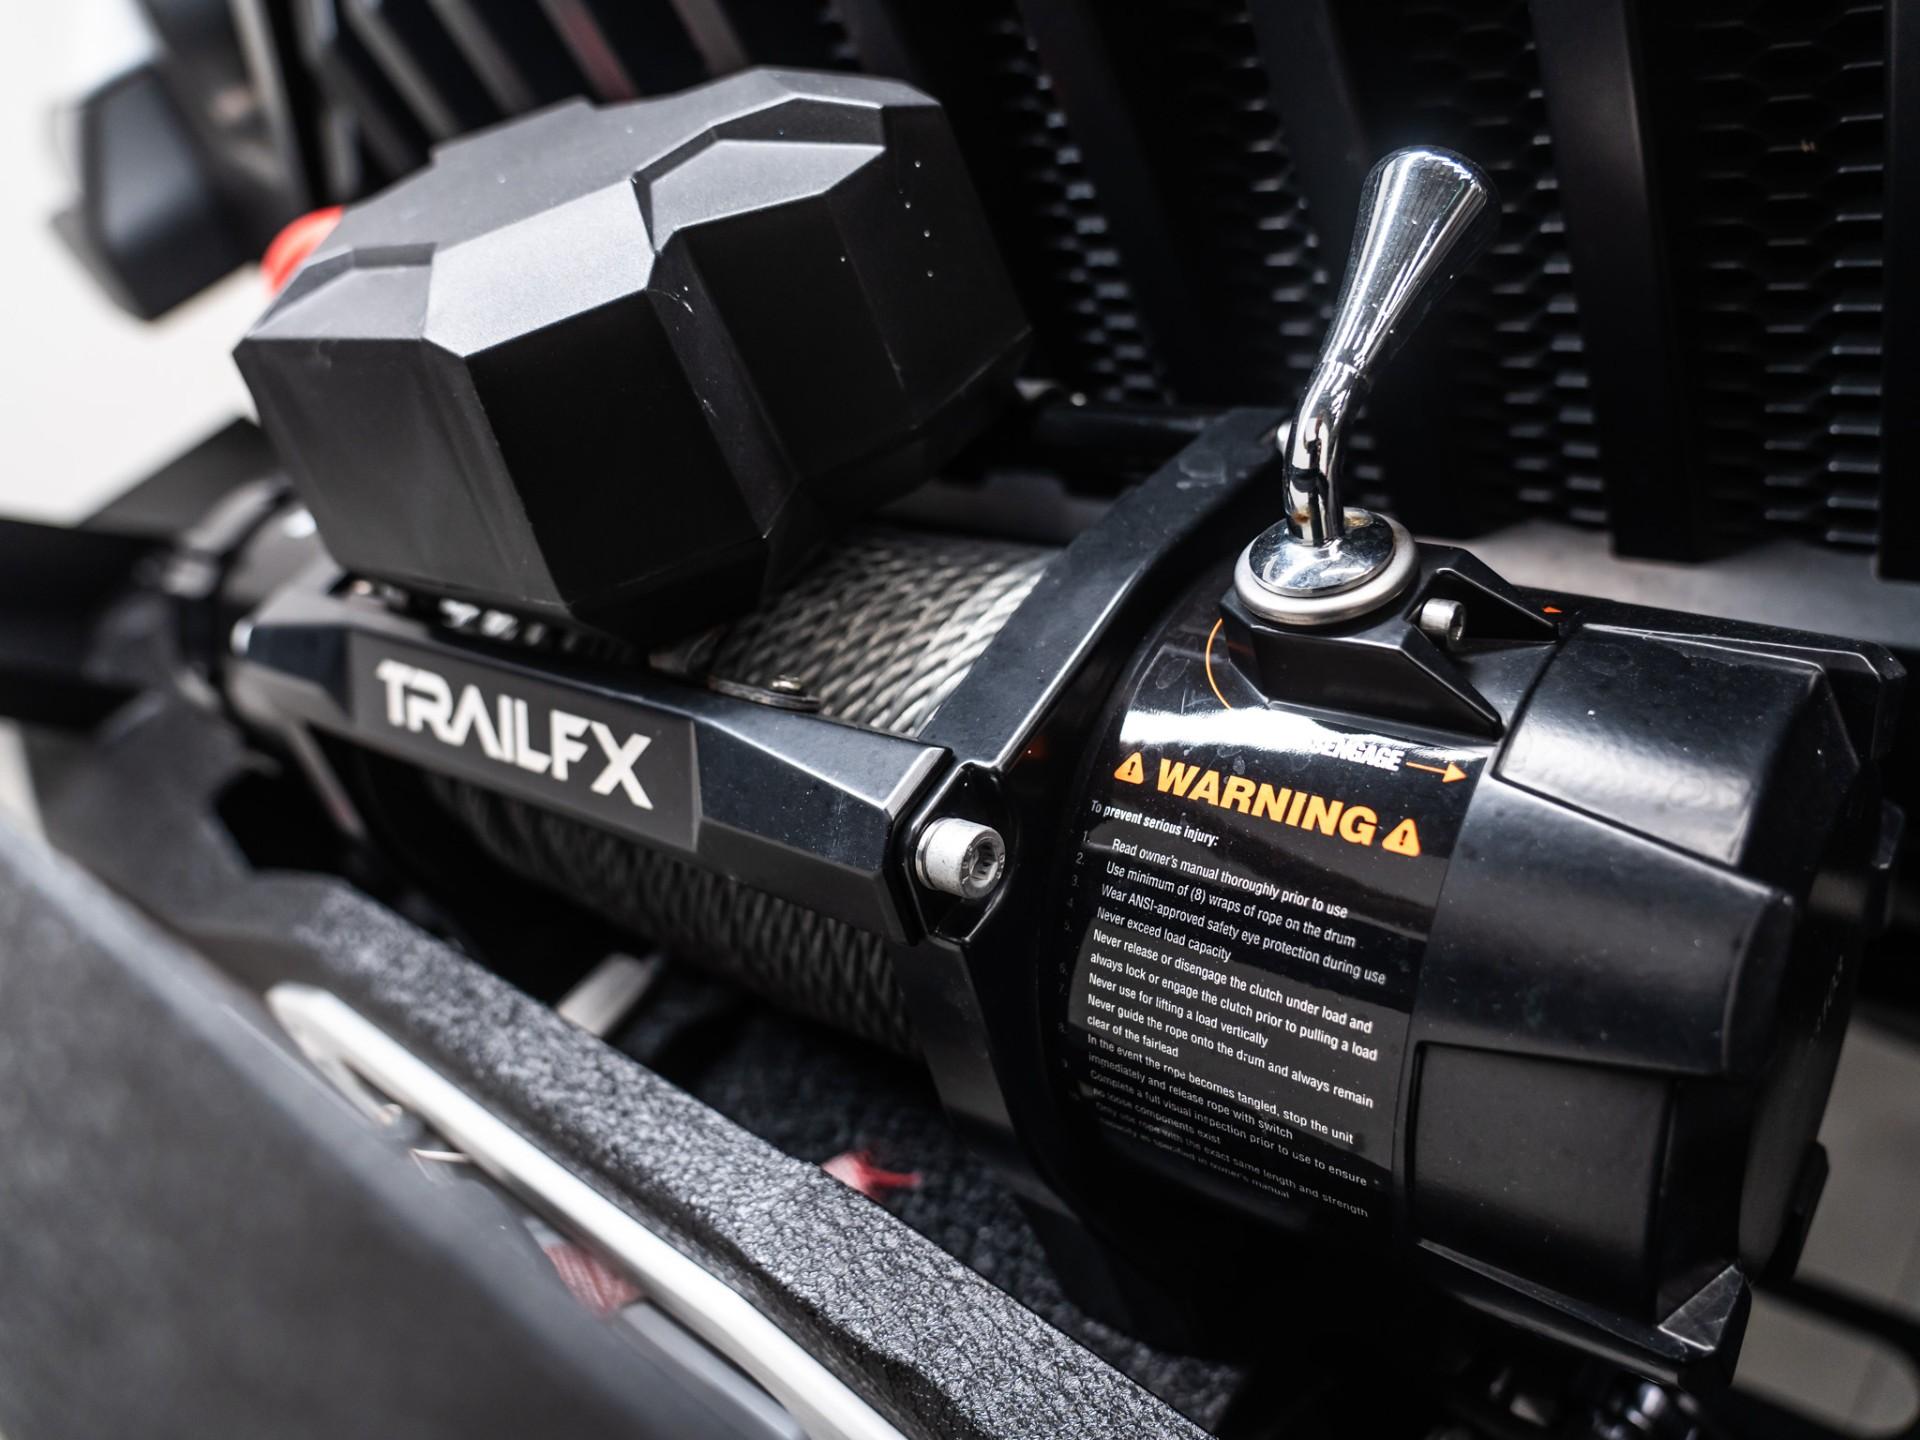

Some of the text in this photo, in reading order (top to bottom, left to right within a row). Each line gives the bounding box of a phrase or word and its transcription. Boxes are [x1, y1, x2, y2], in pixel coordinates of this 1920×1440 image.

[375, 659, 653, 810] TRAILFX
[1090, 799, 1219, 847] To prevent serious injury:
[1156, 758, 1378, 846] WARNING
[1106, 860, 1125, 878] Use
[1126, 869, 1175, 893] minimum
[1176, 884, 1190, 897] of
[1189, 886, 1206, 905] (8)
[1208, 894, 1241, 913] wraps
[1242, 904, 1256, 917] of
[1256, 908, 1283, 926] rope
[1284, 917, 1300, 931] on
[1302, 920, 1321, 938] the
[1323, 927, 1356, 948] drum
[1111, 838, 1138, 856] Read
[1138, 848, 1178, 868] owner's
[1179, 860, 1219, 880] manual
[1220, 870, 1280, 901] thoroughly
[1280, 890, 1310, 907] prior
[1311, 896, 1324, 912] to
[1325, 903, 1348, 918] use
[1096, 906, 1126, 926] Never
[1126, 918, 1162, 938] exceed
[1163, 927, 1186, 946] load
[1187, 938, 1232, 963] capacity
[1101, 883, 1127, 902] Wear
[1127, 892, 1206, 927] ANSI-approved
[1206, 919, 1240, 940] safety
[1240, 930, 1260, 945] eye
[1261, 936, 1320, 964] protection
[1322, 954, 1361, 980] during
[1363, 968, 1386, 985] use
[1088, 972, 1117, 992] Never
[1118, 985, 1136, 999] use
[1138, 990, 1153, 1005] for
[1155, 996, 1184, 1019] lifting
[1186, 1009, 1193, 1020] a
[1195, 1010, 1218, 1029] load
[1220, 1021, 1268, 1048] vertically
[1090, 952, 1378, 1061] always lock or engage the clutch prior to pulling a load
[1092, 928, 1122, 948] Never
[1123, 941, 1159, 961] release
[1160, 953, 1173, 965] or
[1174, 956, 1227, 985] disengage
[1229, 975, 1247, 991] the
[1248, 983, 1283, 1004] clutch
[1285, 995, 1320, 1015] under
[1321, 1005, 1348, 1025] load
[1348, 1017, 1373, 1034] and
[1086, 1015, 1178, 1057] clear of the fairlead
[1087, 993, 1116, 1013] Never
[1117, 1006, 1144, 1024] guide
[1146, 1015, 1163, 1030] the
[1164, 1024, 1188, 1040] rope
[1190, 1033, 1214, 1050] onto
[1216, 1040, 1234, 1057] the
[1235, 1049, 1265, 1068] drum
[1267, 1061, 1289, 1077] and
[1290, 1069, 1330, 1092] always
[1332, 1085, 1373, 1108] remain
[1087, 1033, 1097, 1045] In
[1099, 1038, 1115, 1052] the
[1116, 1046, 1143, 1064] event
[1144, 1055, 1161, 1070] the
[1163, 1064, 1186, 1079] rope
[1188, 1071, 1235, 1099] becomes
[1282, 1110, 1307, 1127] stop
[1310, 1119, 1328, 1134] the
[1331, 1128, 1353, 1144] unit
[1147, 1076, 1166, 1090] and
[1168, 1084, 1204, 1105] release
[1206, 1099, 1230, 1116] rope
[1232, 1109, 1255, 1125] with
[1257, 1119, 1293, 1140] switch
[1193, 1110, 1247, 1139] inspection
[1249, 1134, 1275, 1150] prior
[1277, 1143, 1289, 1156] to
[1291, 1151, 1311, 1164] use
[1314, 1157, 1326, 1170] to
[1327, 1164, 1367, 1186] ensure
[1298, 1184, 1319, 1198] and
[1321, 1193, 1368, 1217] strength
